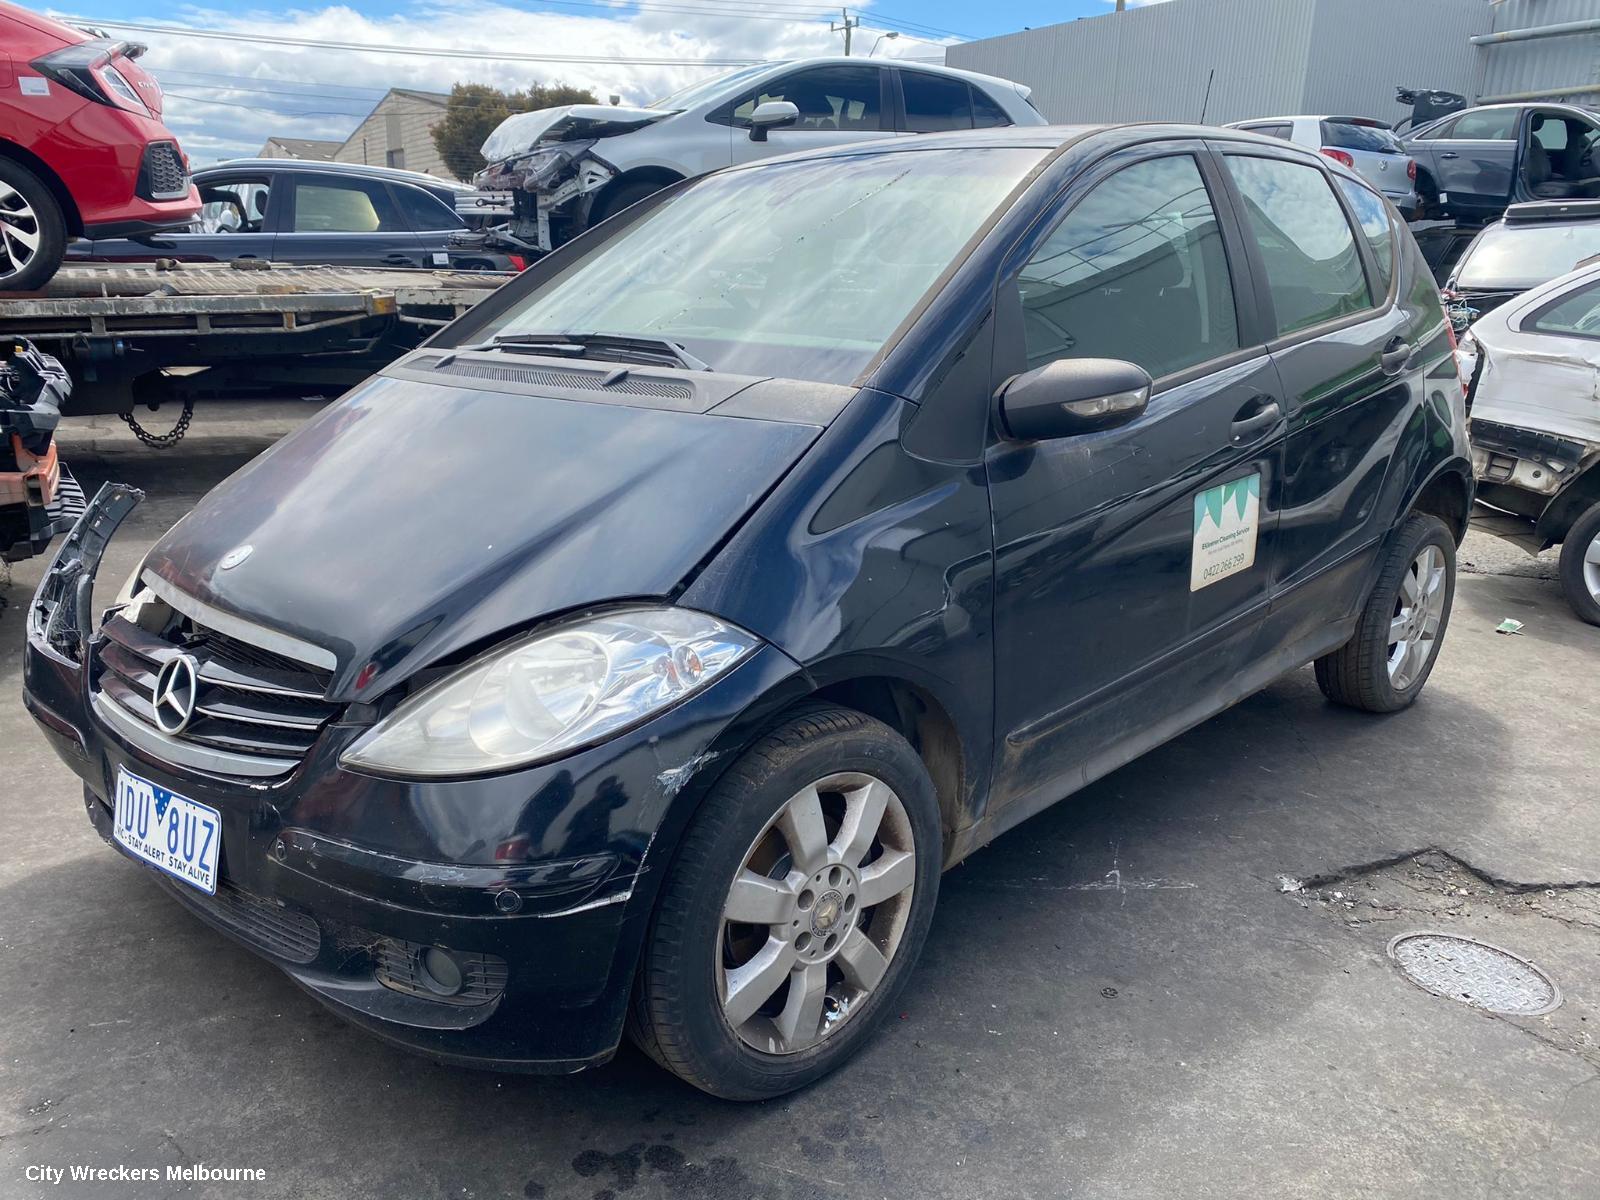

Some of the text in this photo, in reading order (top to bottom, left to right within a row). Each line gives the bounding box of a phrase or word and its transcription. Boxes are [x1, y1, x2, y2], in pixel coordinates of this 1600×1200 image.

[128, 834, 143, 851] STAY
[143, 844, 165, 863] ALERT
[168, 856, 187, 875] STAY
[188, 866, 210, 885] ALIVE
[167, 807, 214, 872] 8UZ
